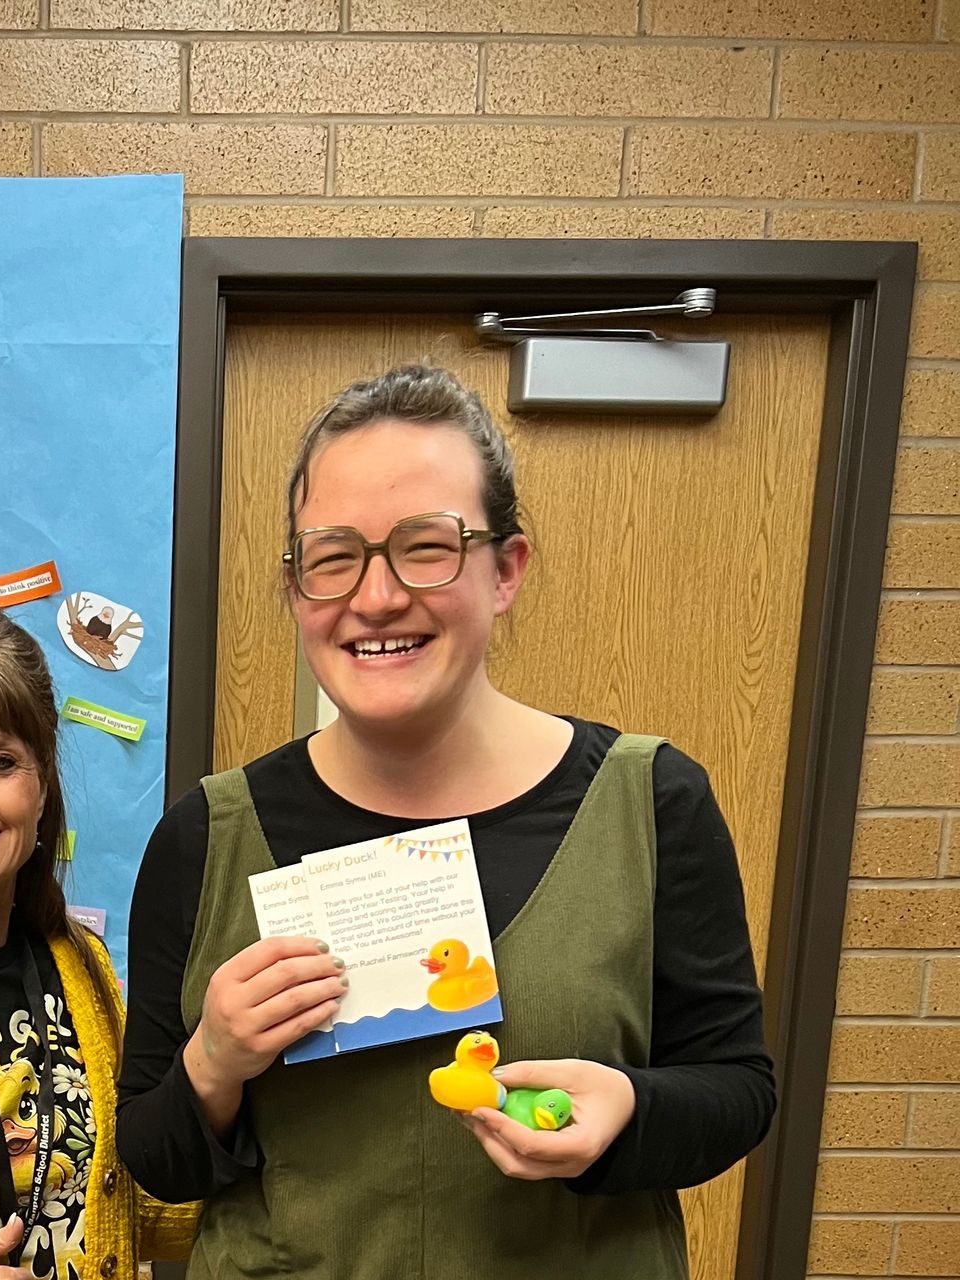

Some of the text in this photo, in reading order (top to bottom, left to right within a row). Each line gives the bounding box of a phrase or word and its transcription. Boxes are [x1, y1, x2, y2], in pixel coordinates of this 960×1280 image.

[7, 581, 26, 592] think
[26, 575, 51, 588] positive
[80, 709, 93, 719] safe
[93, 713, 107, 722] and
[308, 851, 377, 877] Lucky Duck!
[256, 879, 289, 895] Lucky
[320, 880, 344, 891] Emma
[368, 870, 386, 880] (ME)
[325, 899, 347, 909] Thank
[349, 896, 362, 904] you
[395, 885, 410, 893] your
[412, 880, 429, 889] help
[430, 876, 445, 884] with
[326, 907, 350, 918] Middle
[361, 901, 378, 909] Year
[412, 889, 428, 898] Your
[431, 886, 446, 894] help
[263, 900, 287, 910] Emma
[328, 917, 353, 928] testing
[354, 913, 368, 921] and
[370, 907, 397, 918] scoring
[415, 896, 440, 908] greatly
[421, 906, 438, 914] have
[441, 902, 459, 910] done
[267, 917, 289, 927] Thank
[292, 914, 305, 922] you
[357, 930, 375, 939] short
[376, 924, 404, 934] amount
[415, 918, 430, 926] time
[432, 911, 458, 922] without
[460, 908, 476, 917] your
[355, 941, 370, 949] You
[385, 929, 423, 942] Awesome!
[359, 956, 386, 967] Rachel
[387, 946, 428, 961] Farnsworth
[40, 1114, 50, 1149] District
[34, 1149, 48, 1185] School
[29, 1186, 40, 1226] Sanpete
